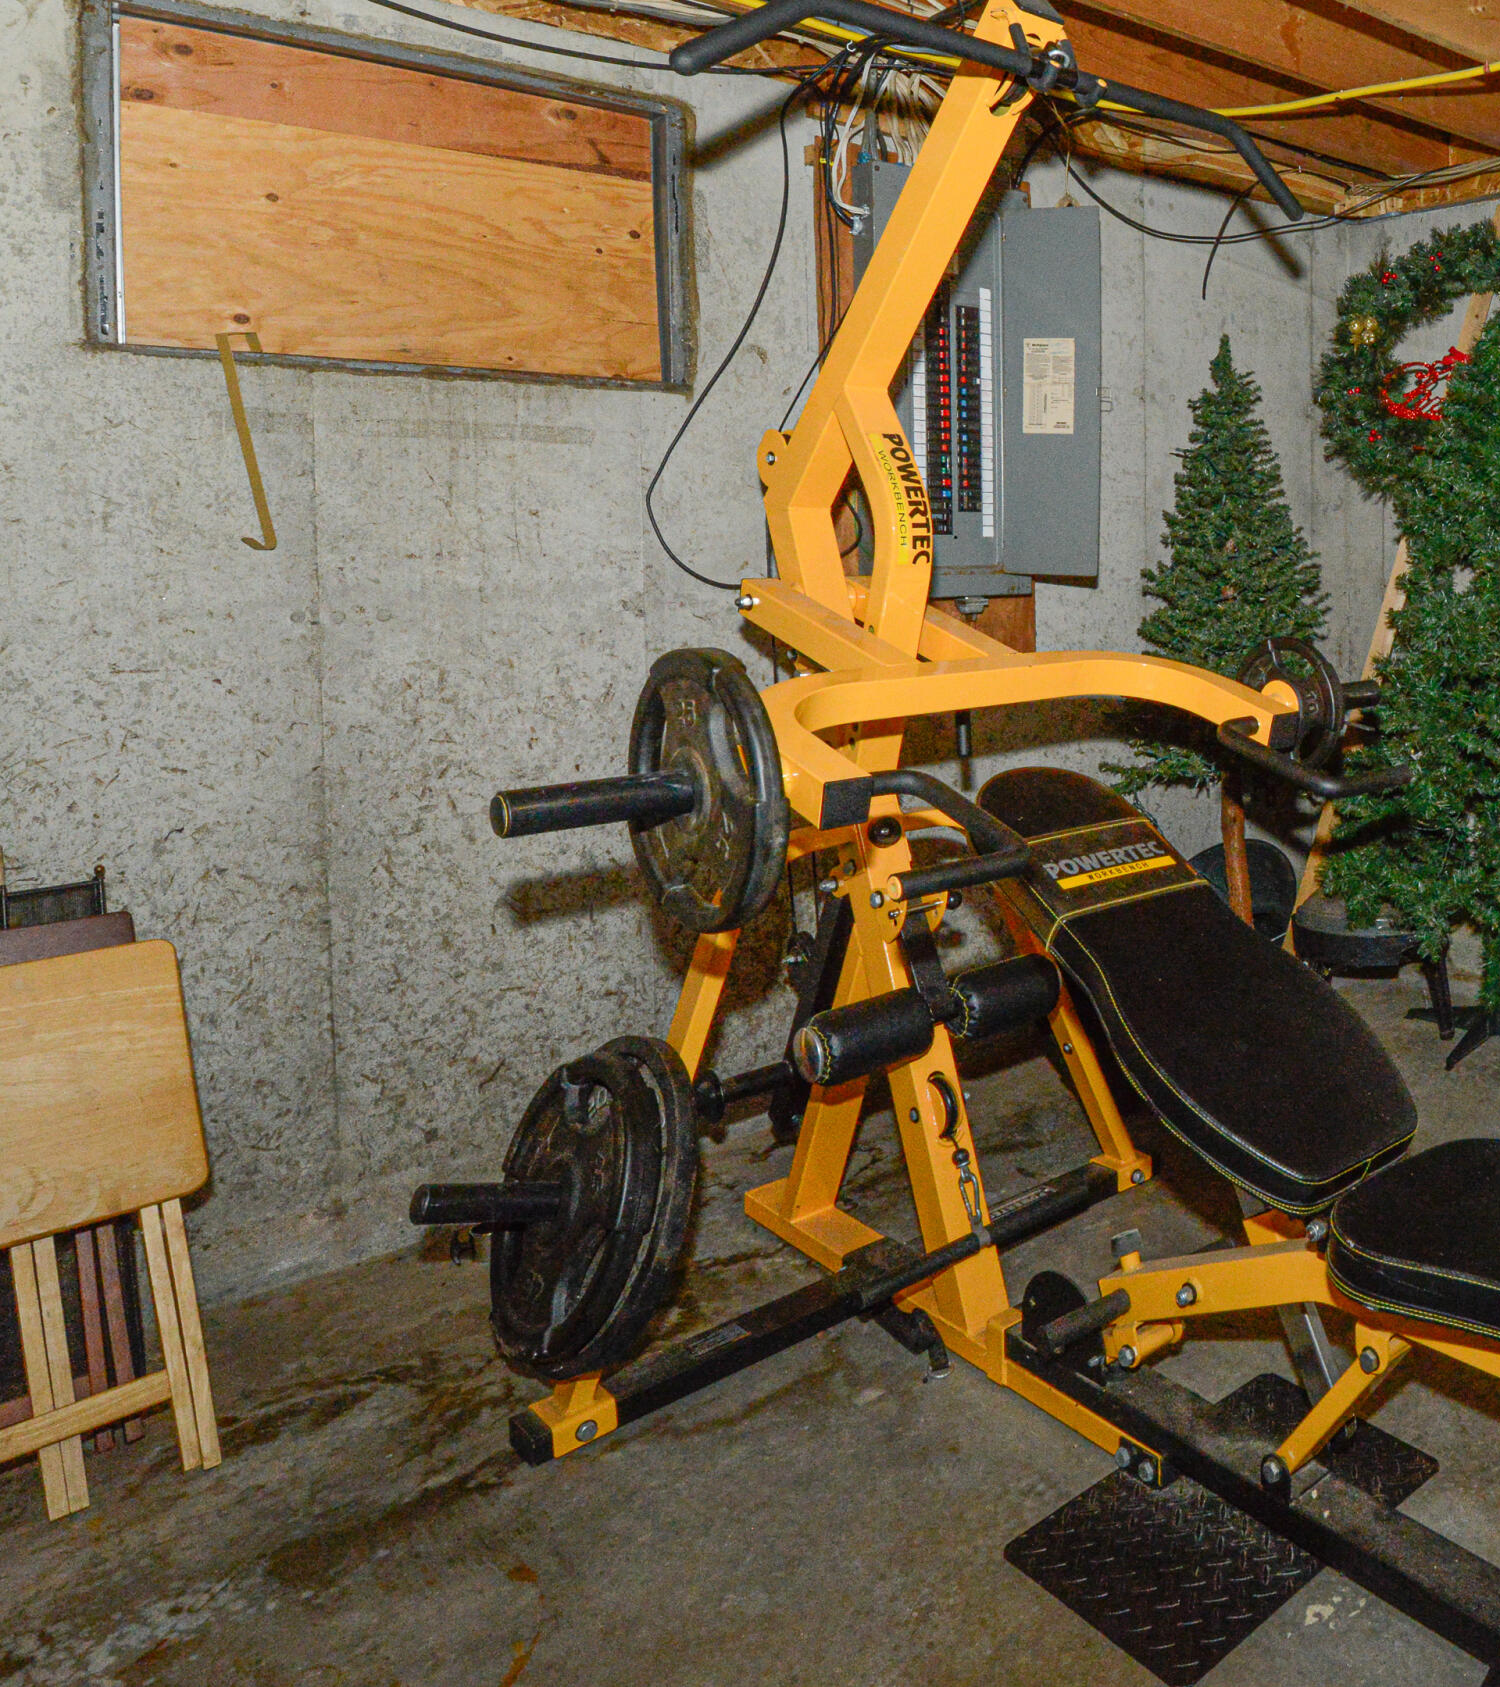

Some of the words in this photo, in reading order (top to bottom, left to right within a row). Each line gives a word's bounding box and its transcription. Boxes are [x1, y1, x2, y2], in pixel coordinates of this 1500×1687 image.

[878, 449, 908, 546] WORKBENCH
[881, 432, 931, 565] POWERTEC
[1042, 841, 1166, 879] POWERTEC
[1088, 862, 1151, 881] WORKBENCH
